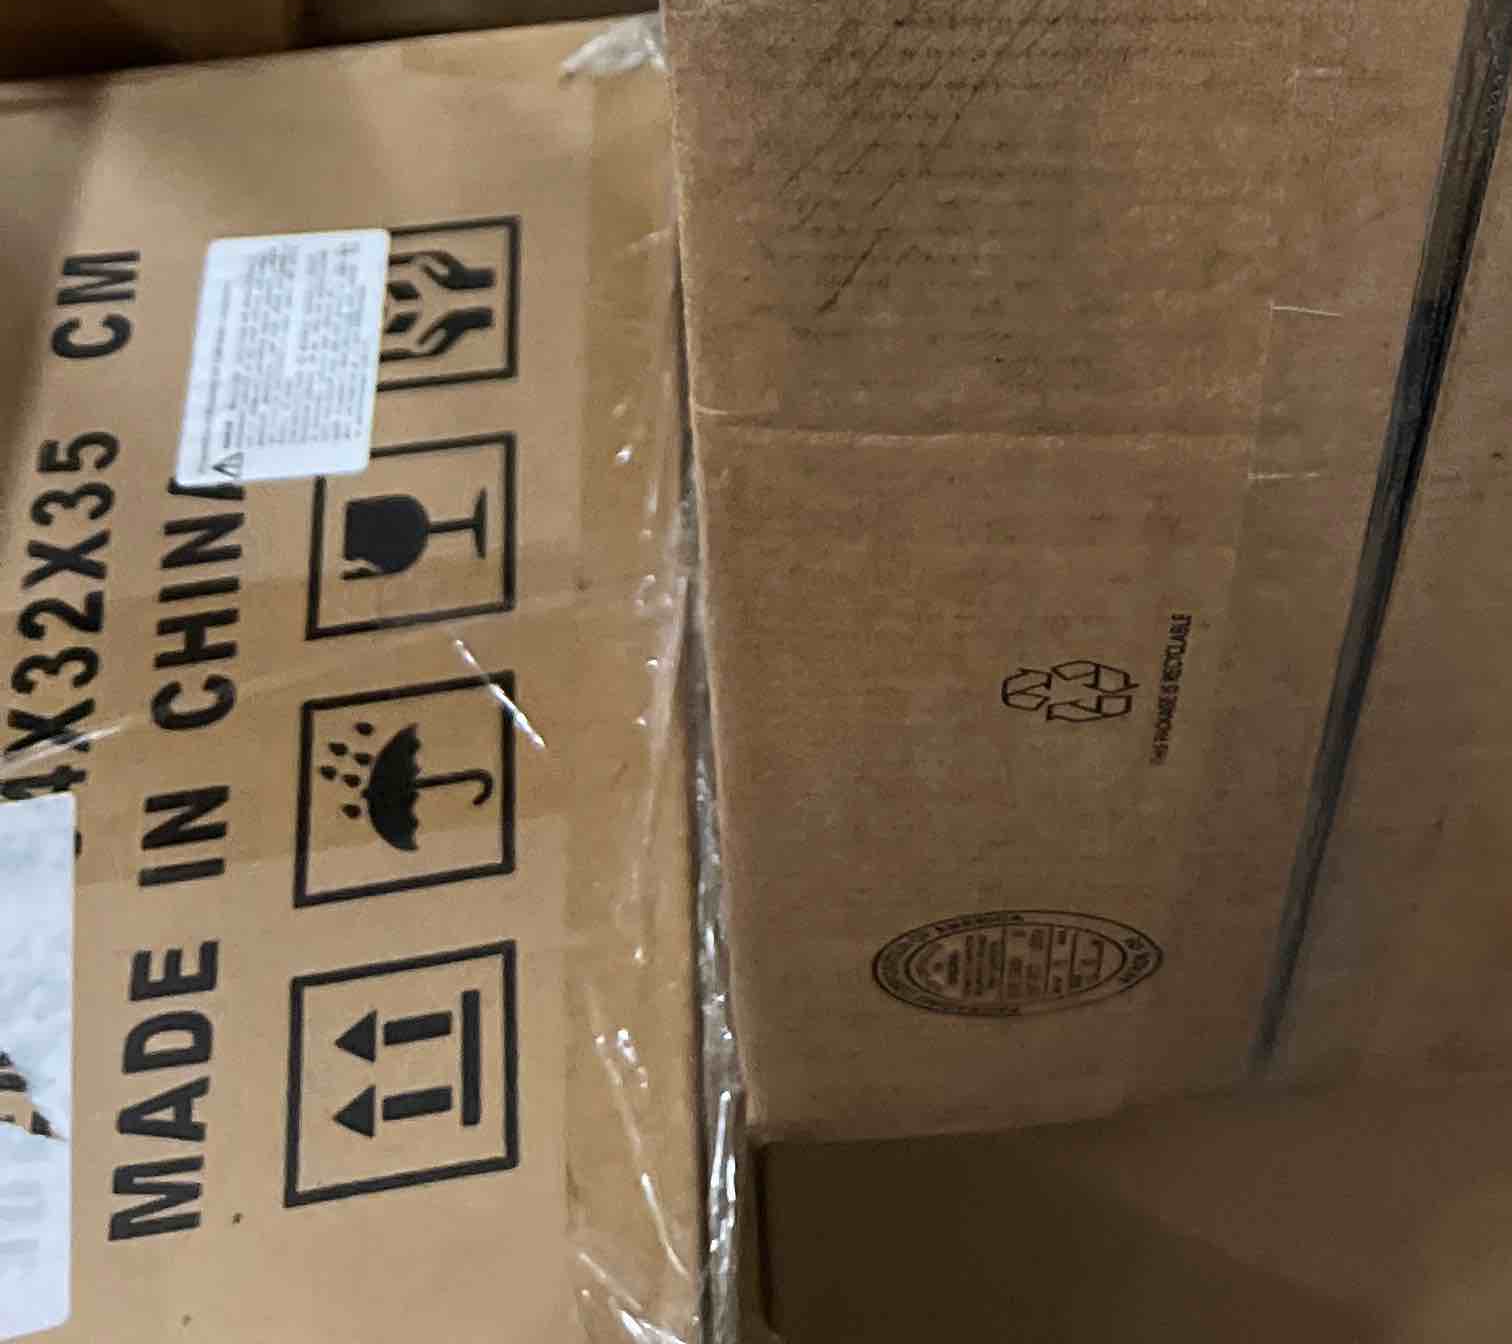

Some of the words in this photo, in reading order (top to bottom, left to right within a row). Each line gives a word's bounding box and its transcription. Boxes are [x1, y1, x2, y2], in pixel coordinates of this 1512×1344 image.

[51, 250, 141, 360] CM
[0, 430, 121, 858] 4X32X35
[138, 785, 231, 888] IN
[108, 940, 220, 1242] MADE
